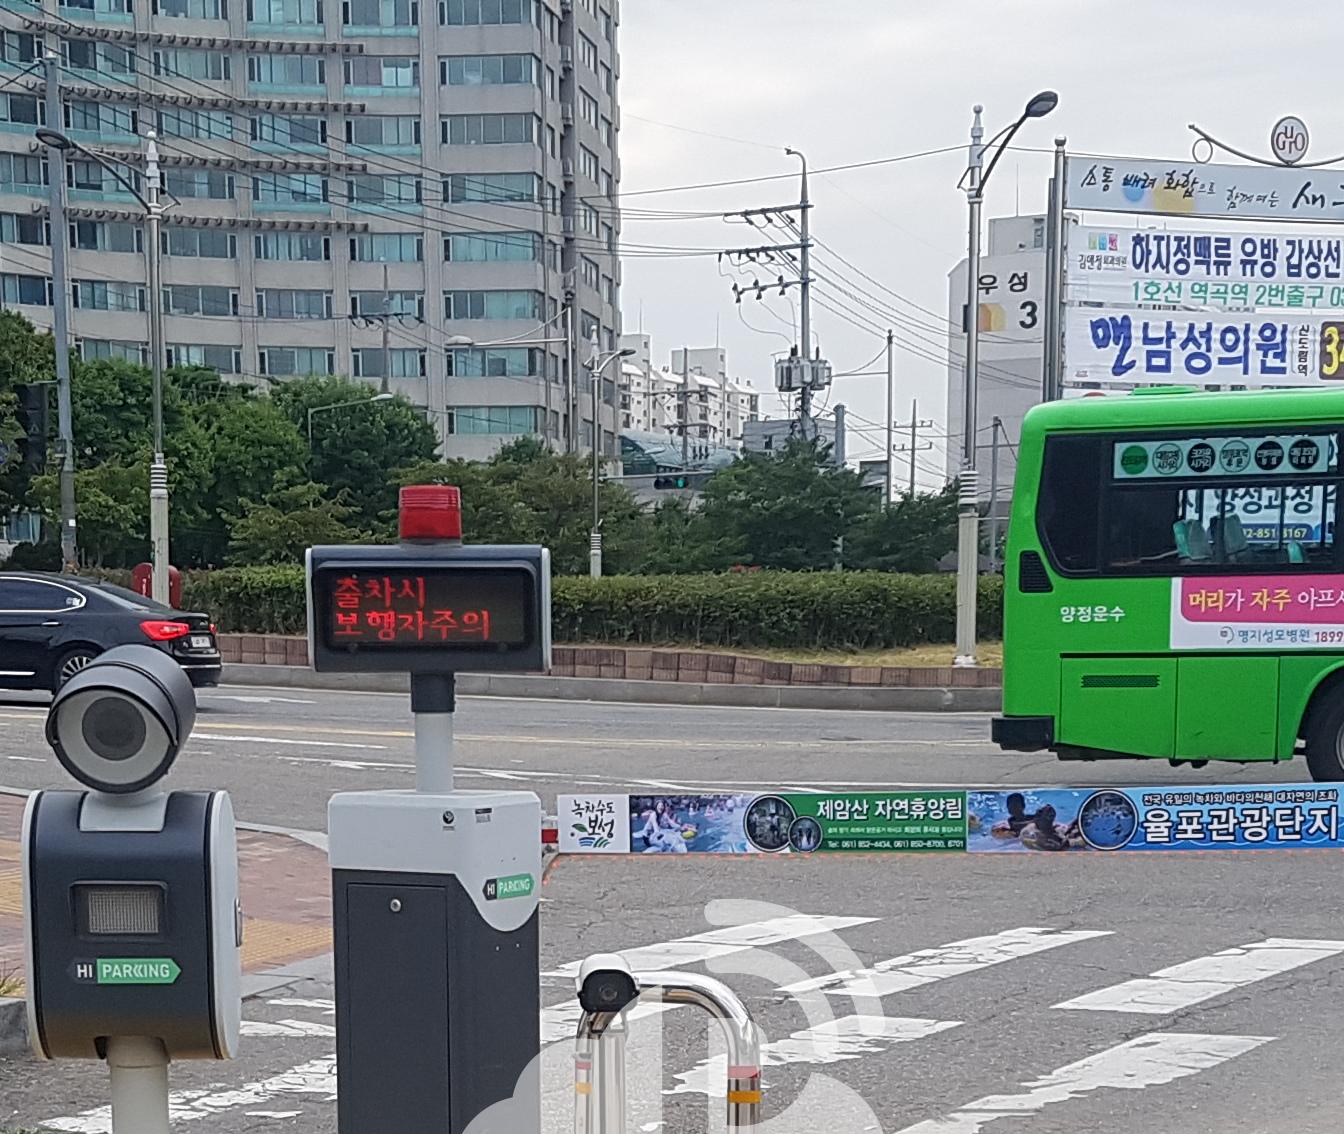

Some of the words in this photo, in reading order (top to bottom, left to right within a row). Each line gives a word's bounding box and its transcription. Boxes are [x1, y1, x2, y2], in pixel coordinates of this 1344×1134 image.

[1081, 165, 1114, 192] 소통
[1122, 172, 1157, 189] 배려
[1163, 169, 1216, 199] 화합으로
[1292, 181, 1325, 210] 새
[1131, 233, 1232, 277] 하지정맥류
[1240, 237, 1278, 278] 유방
[1285, 239, 1341, 279] 갑상선
[978, 271, 1028, 295] 우성
[1133, 281, 1182, 304] 1호선
[1190, 283, 1249, 306] 역곡역
[1255, 284, 1324, 308] 2번출구
[1019, 300, 1038, 329] 3
[334, 576, 426, 609] 출차시
[1188, 589, 1245, 613] 머리가
[1249, 589, 1292, 612] 자주
[334, 609, 491, 641] 보행자주의
[1060, 605, 1126, 623] 양정운수
[1238, 629, 1310, 643] 명지성모병원
[571, 799, 616, 818] 녹차수도
[816, 798, 869, 820] 제암산
[874, 797, 963, 820] 자연휴양림
[1143, 794, 1162, 806] 전국
[1165, 793, 1192, 805] 유일의
[1276, 790, 1315, 802] 대자연의
[588, 817, 615, 838] 보성
[1142, 806, 1339, 842] 율포관광단지
[487, 883, 495, 896] HI
[76, 963, 93, 979] HI
[102, 963, 171, 980] PARKING
